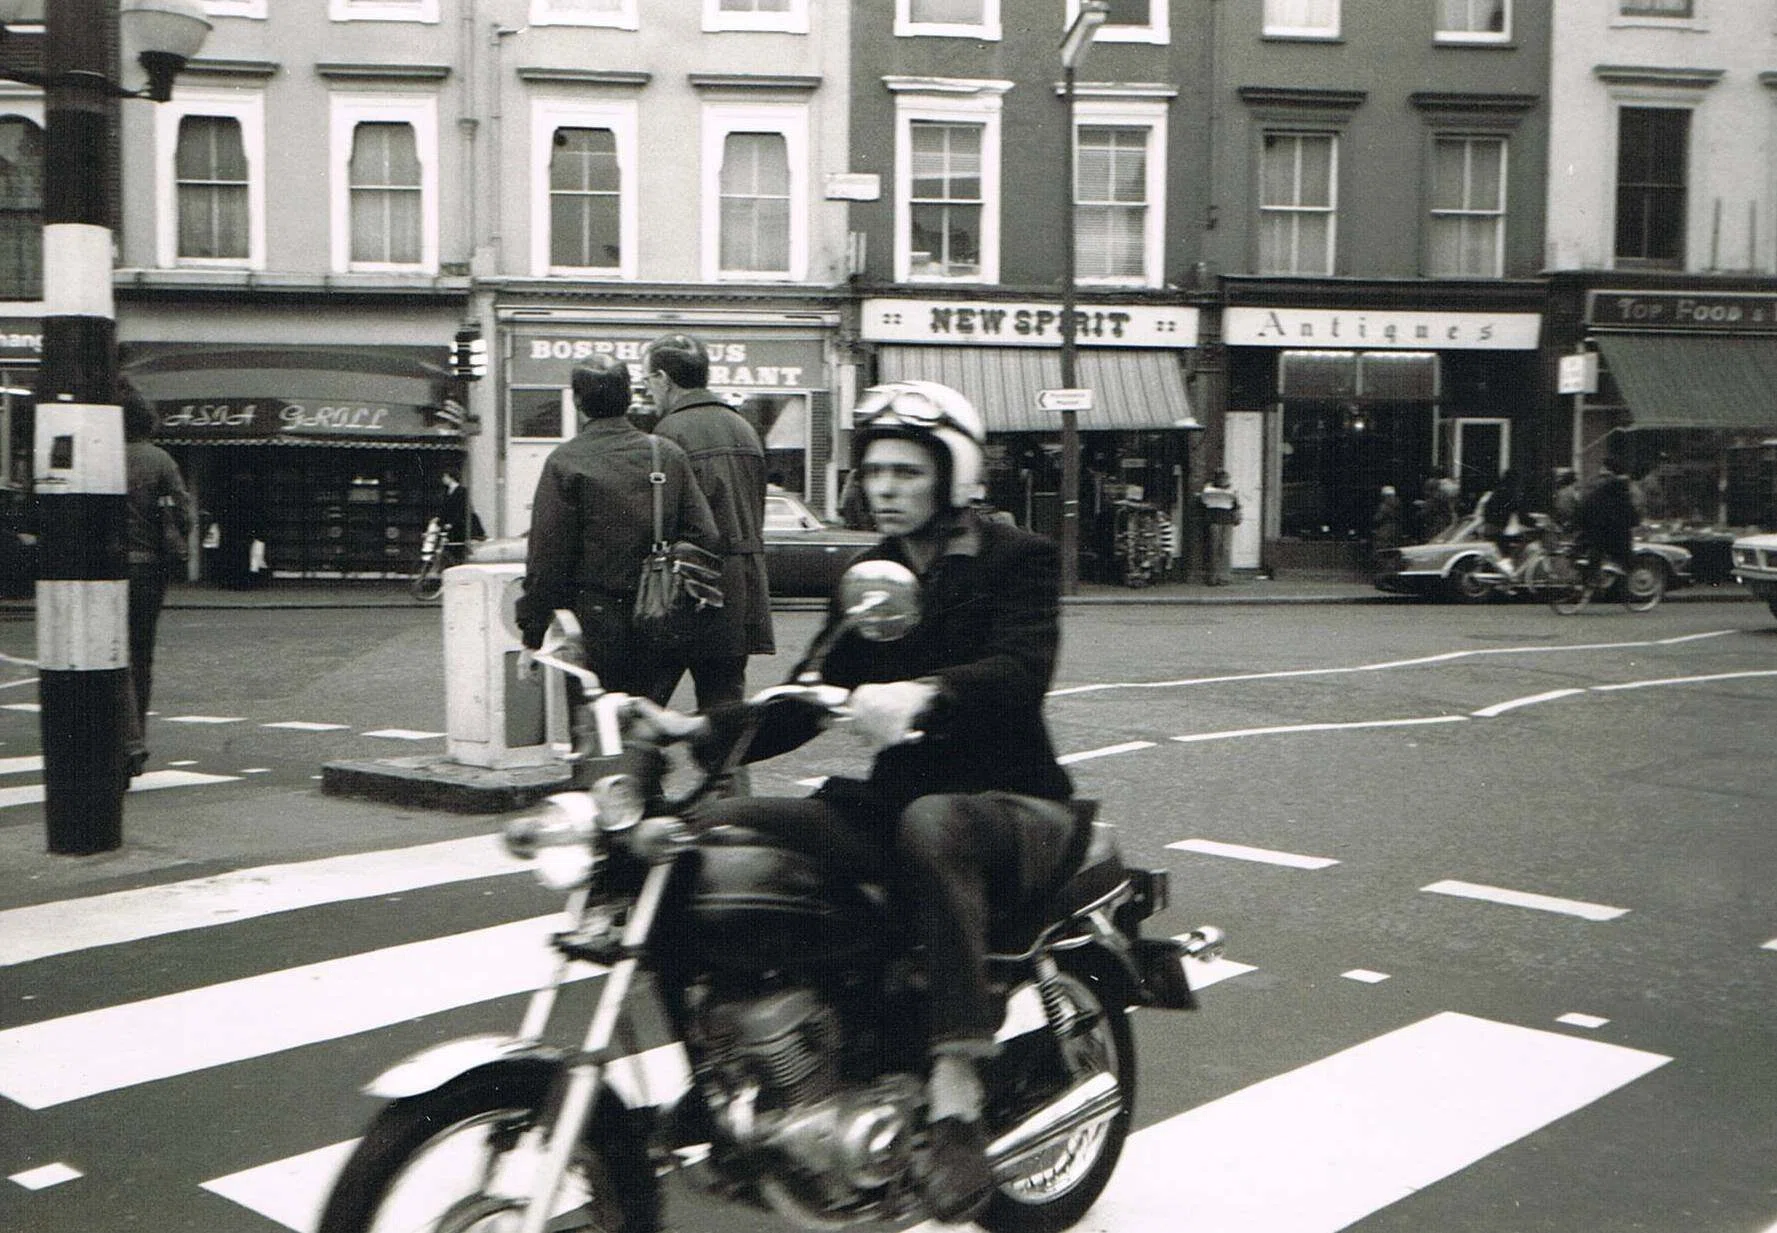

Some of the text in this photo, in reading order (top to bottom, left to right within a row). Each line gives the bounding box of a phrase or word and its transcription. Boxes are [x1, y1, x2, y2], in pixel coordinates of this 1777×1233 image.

[930, 307, 1131, 338] NEW SPIRIT
[1257, 311, 1494, 343] Antiques
